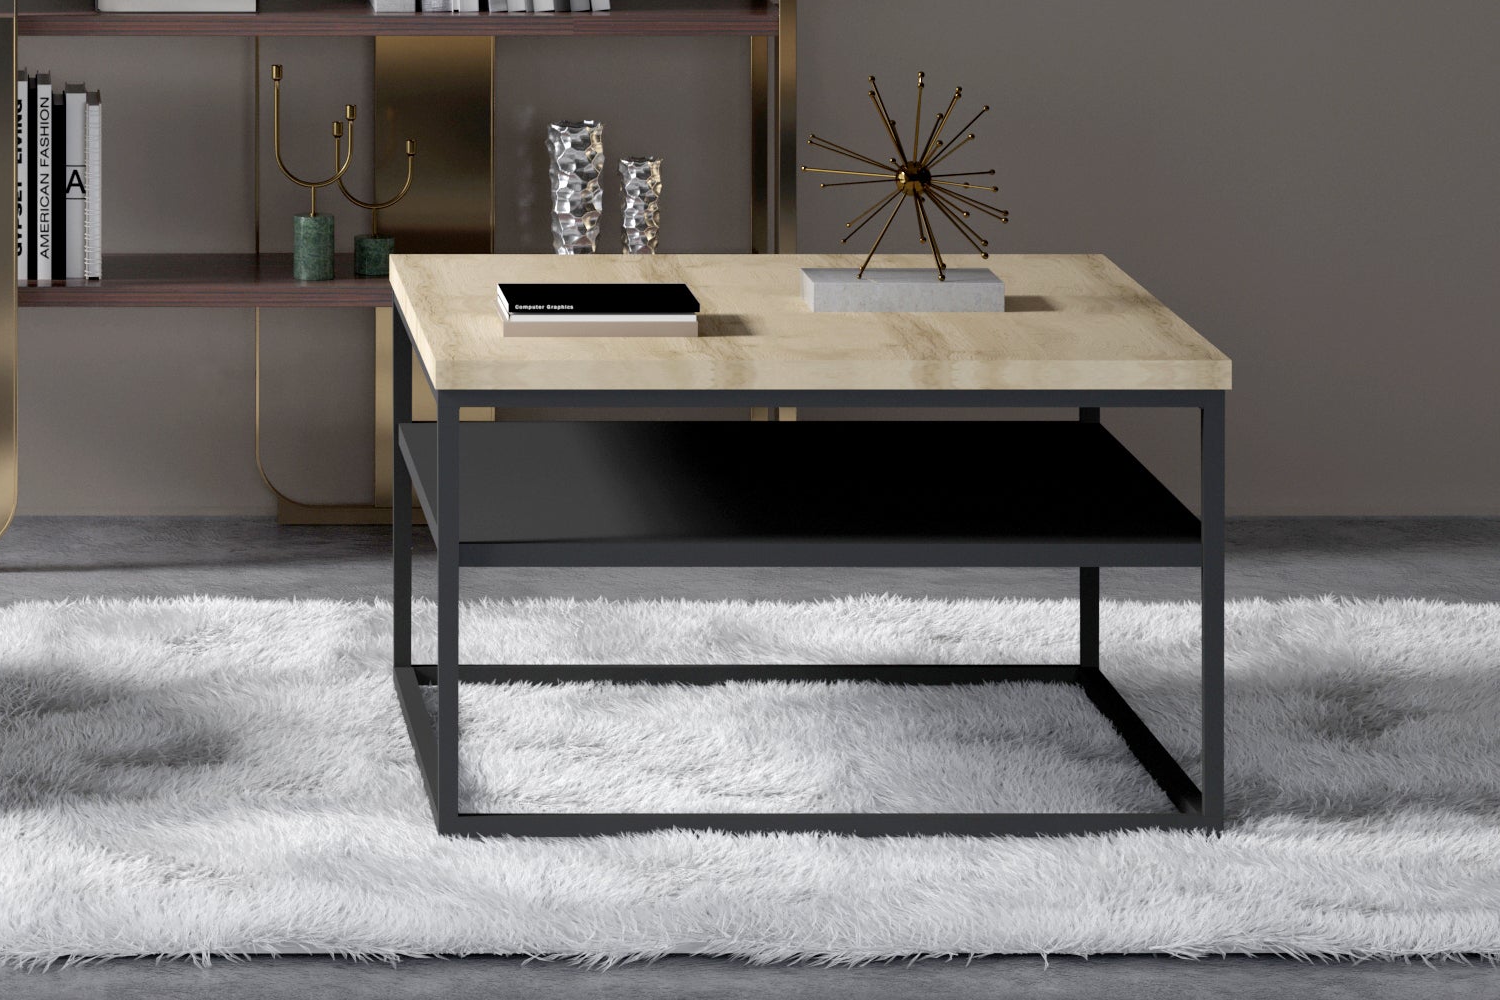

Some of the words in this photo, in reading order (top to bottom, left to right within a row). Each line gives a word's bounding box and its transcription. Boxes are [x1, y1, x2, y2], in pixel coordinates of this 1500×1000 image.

[40, 97, 50, 167] FASHION
[40, 173, 50, 259] AMERICAN
[65, 169, 86, 194] A
